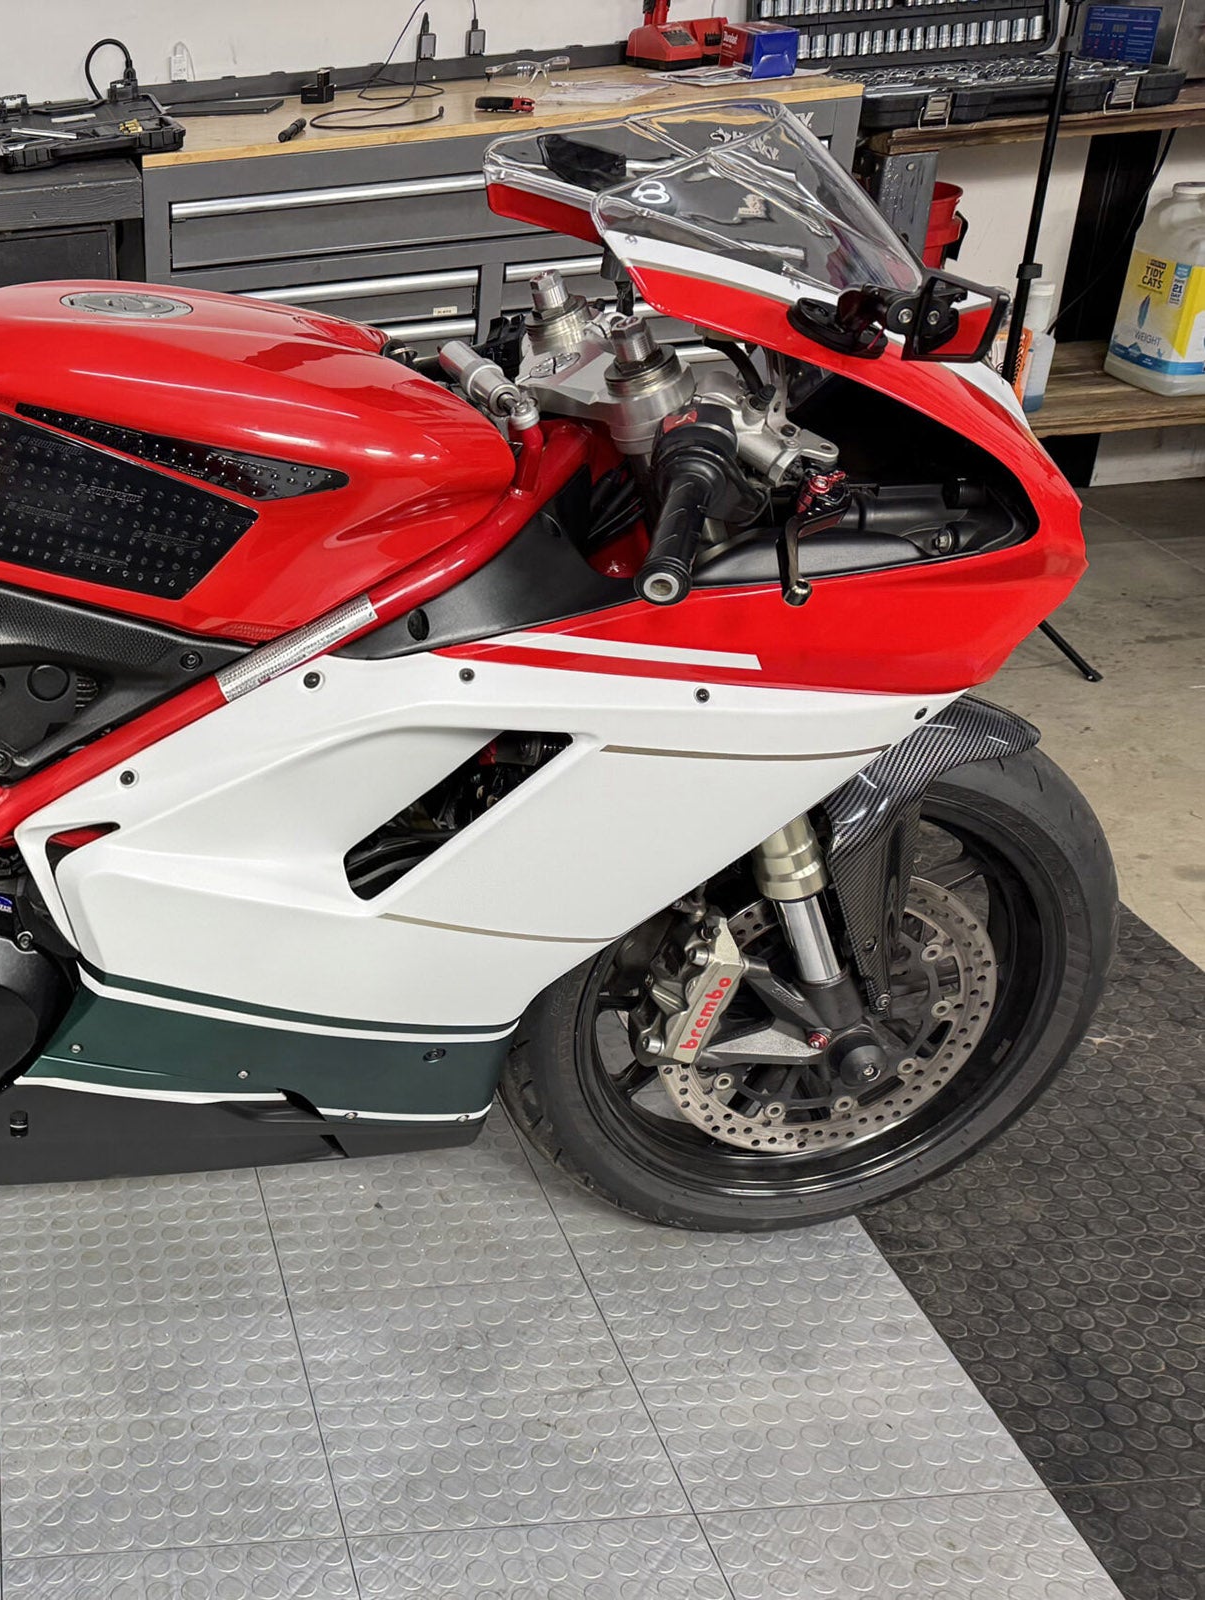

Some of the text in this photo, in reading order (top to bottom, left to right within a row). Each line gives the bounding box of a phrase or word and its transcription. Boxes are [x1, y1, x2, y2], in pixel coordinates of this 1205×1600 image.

[1146, 265, 1164, 279] TIDY
[1141, 275, 1164, 289] CATS
[1172, 283, 1183, 294] 21
[679, 977, 732, 1050] brembo
